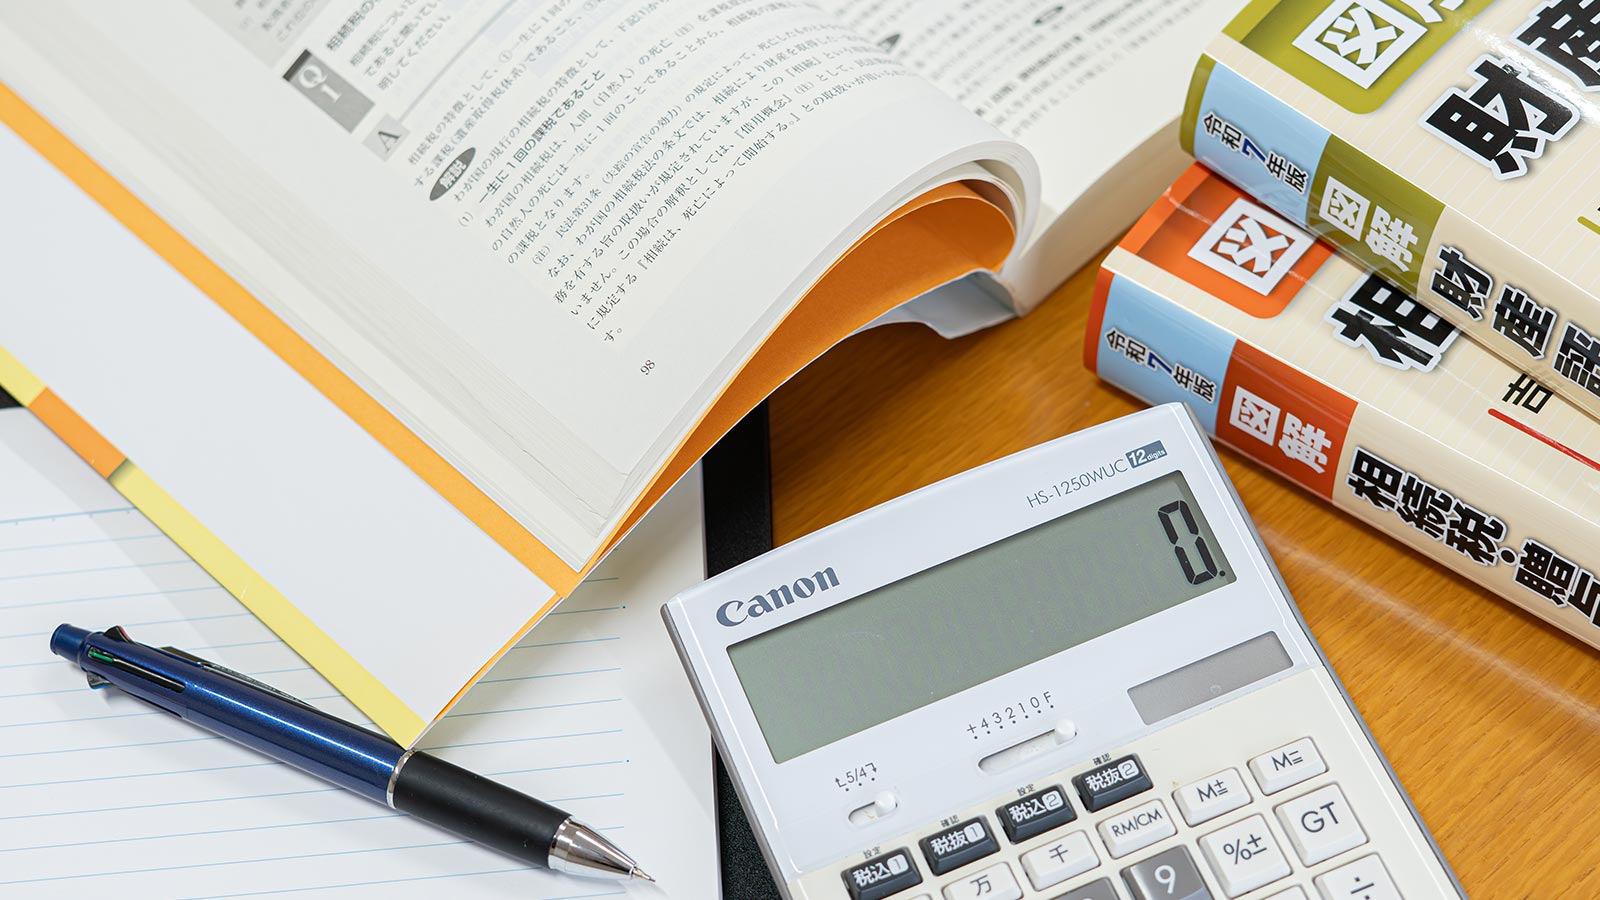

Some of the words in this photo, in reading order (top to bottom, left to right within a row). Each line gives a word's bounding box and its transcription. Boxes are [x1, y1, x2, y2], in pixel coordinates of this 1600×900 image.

[377, 126, 402, 153] A
[1202, 111, 1309, 194] 令和7年版
[440, 159, 467, 190] 解説
[1319, 175, 1418, 272] 図解
[1187, 197, 1317, 296] 図
[603, 327, 621, 340] す。
[1326, 272, 1462, 371] 相
[639, 358, 656, 375] 98
[1105, 328, 1217, 403] 令和7年版
[1229, 386, 1333, 474] 図解
[1026, 457, 1128, 509] HS-1250WUC
[716, 567, 841, 628] Canon
[1111, 808, 1164, 838] RM/CM
[1301, 801, 1340, 834] GT
[1049, 844, 1069, 864] 千
[969, 874, 992, 897] 万
[1154, 865, 1176, 895] 9
